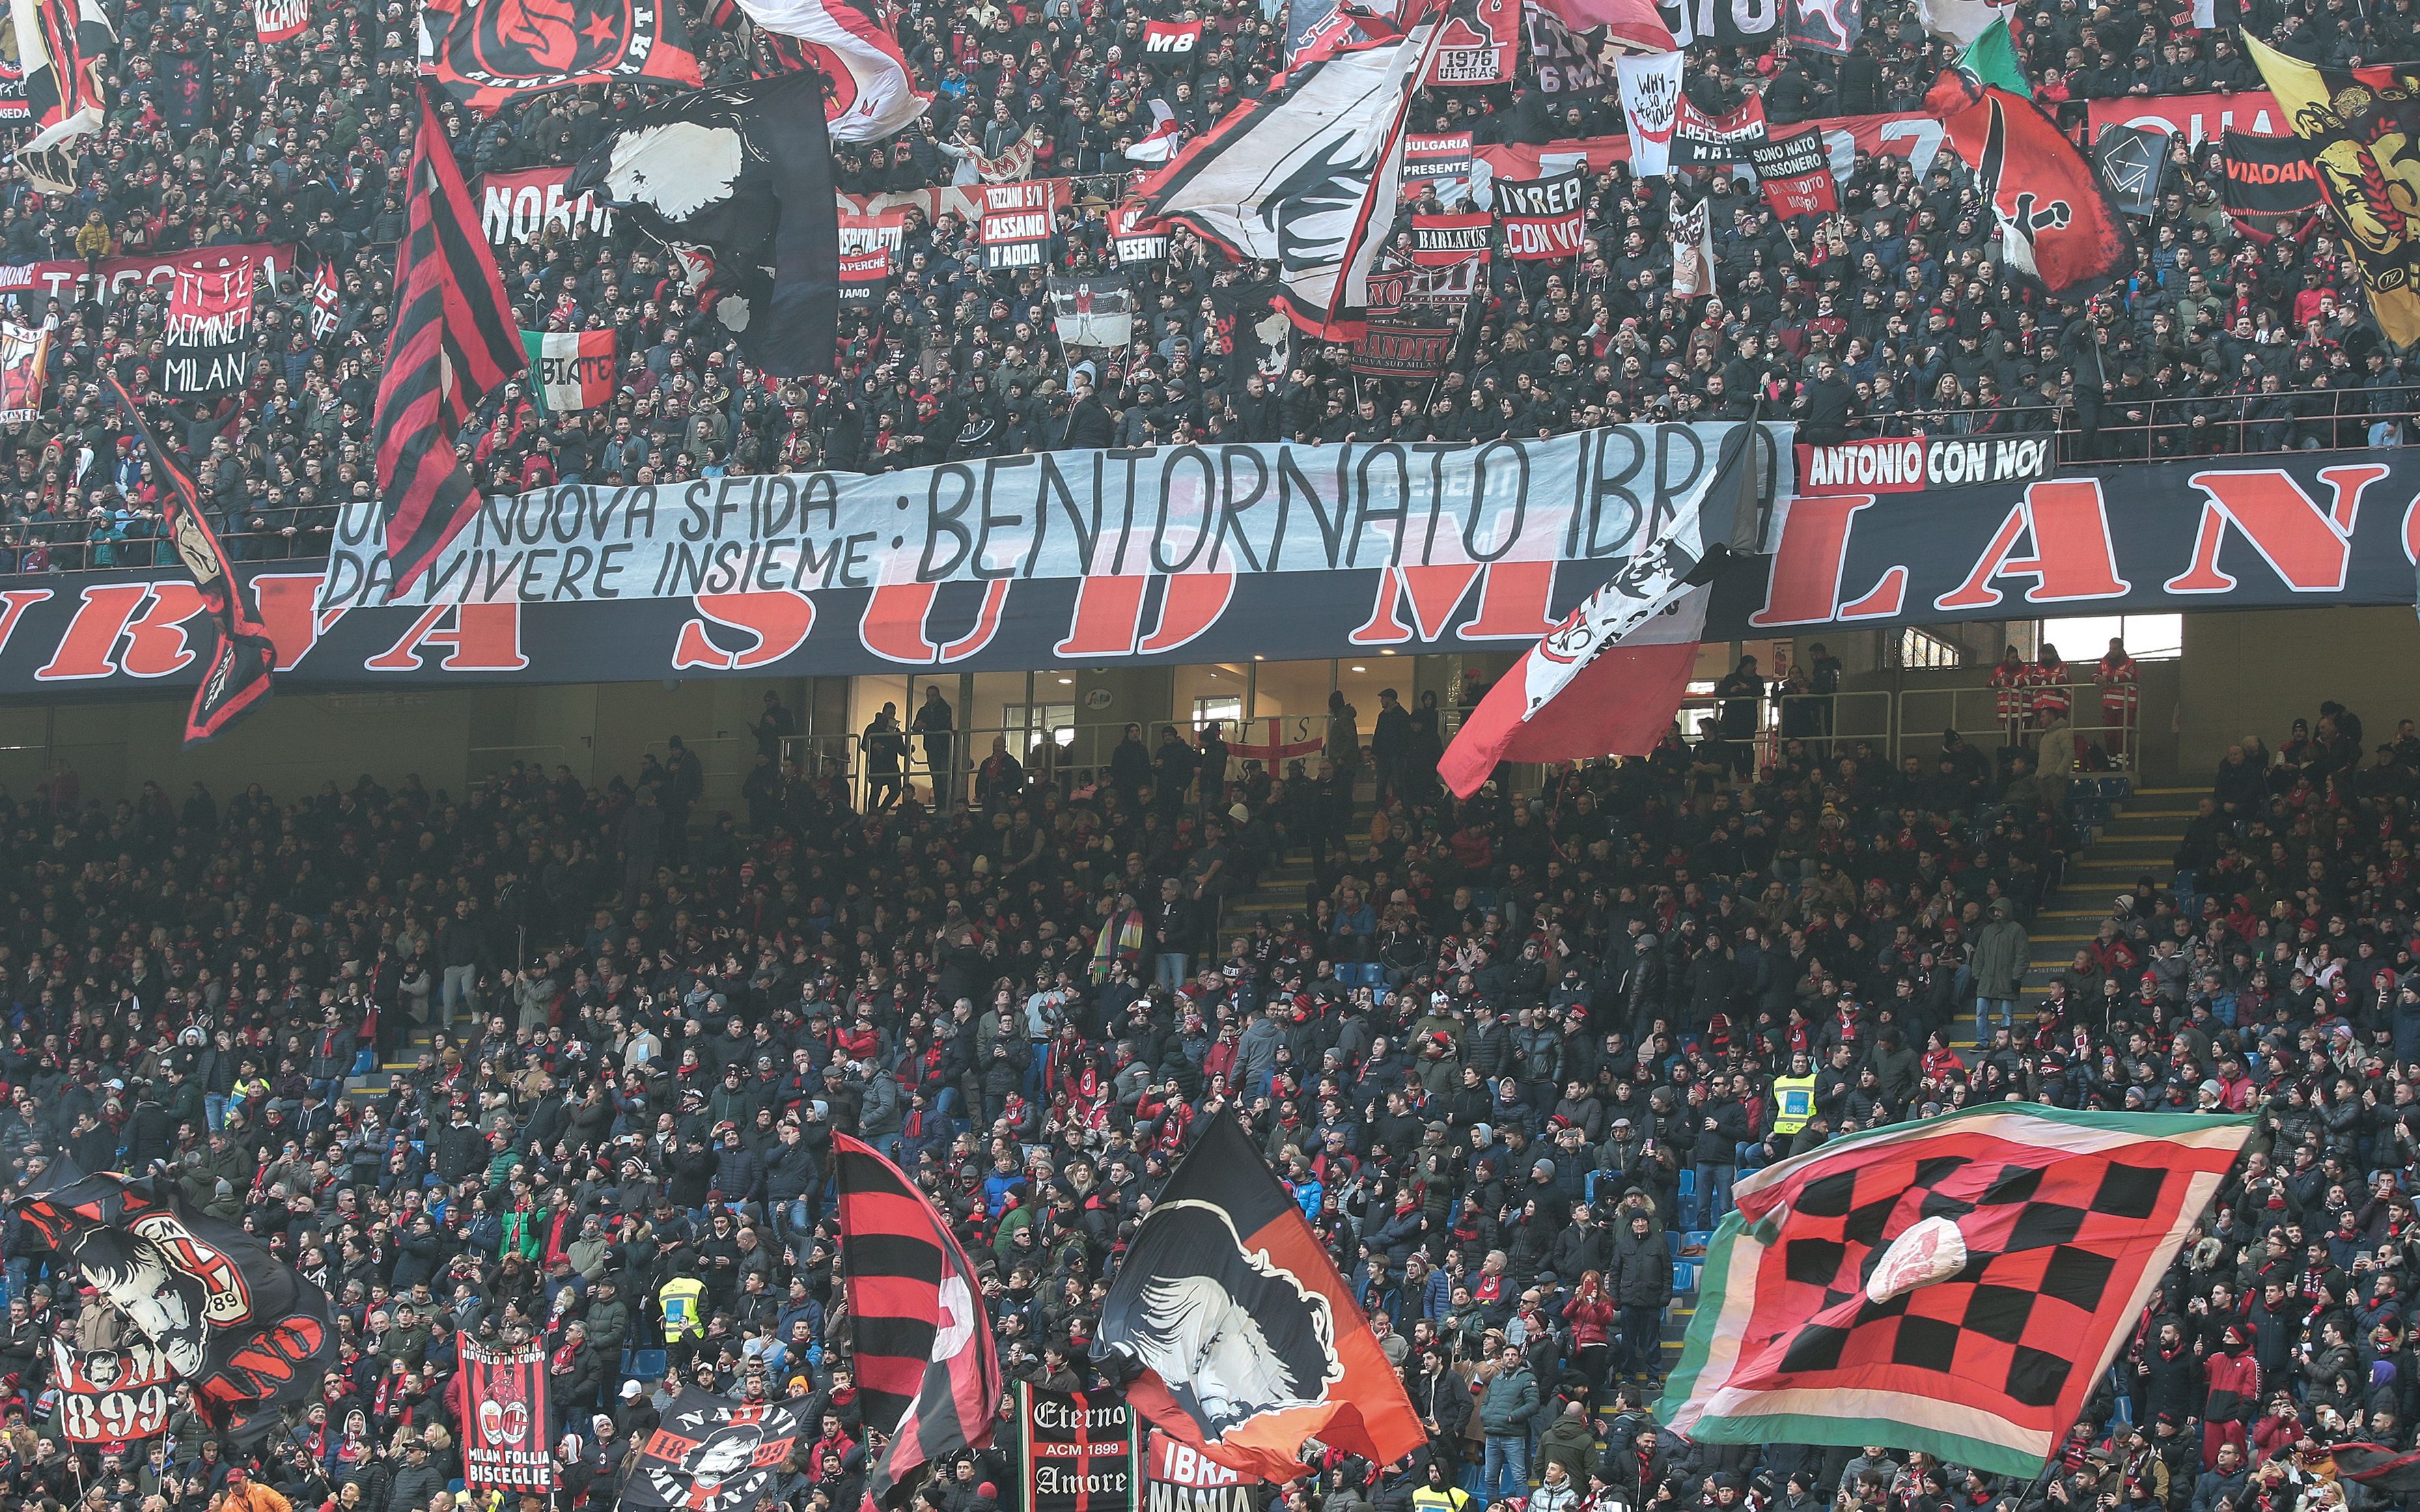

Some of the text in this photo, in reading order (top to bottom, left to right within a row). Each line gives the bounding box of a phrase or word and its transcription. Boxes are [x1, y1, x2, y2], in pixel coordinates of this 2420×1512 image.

[1147, 32, 1195, 53] MB
[1446, 51, 1492, 68] 1976
[1439, 67, 1497, 79] ULTRAS
[1637, 73, 1665, 96] WHY
[1648, 96, 1660, 108] SO
[1728, 107, 1748, 126] TI
[1676, 120, 1764, 145] LASCEREMO
[1406, 139, 1469, 152] BULGARIA
[1752, 136, 1816, 163] SONO NATO
[1404, 162, 1469, 176] PRESENTE
[1757, 154, 1822, 178] ROSSONERO
[1499, 178, 1582, 214] IVREA
[985, 214, 1046, 240] CASSANO
[1507, 220, 1554, 254] CON
[847, 254, 885, 271] PERCHÈ
[989, 243, 1040, 267] D'ADDA
[178, 263, 249, 307] TI TE
[844, 288, 870, 298] AMO
[167, 306, 249, 348] DOMINET
[1352, 334, 1450, 361] BANDITI
[164, 351, 246, 392] MILAN
[1384, 360, 1404, 368] SUD
[1809, 438, 2048, 486] ANTONIO CON NOI
[473, 484, 658, 547] NUOVA
[679, 472, 838, 542] SFIDA
[915, 439, 1530, 583] BENTORNATO
[423, 542, 634, 604] VIVERE
[652, 531, 878, 598] INSIEME
[462, 1349, 546, 1366] DIAVOLO IN CORPO
[1033, 1400, 1127, 1430] Eterno
[468, 1447, 550, 1465] MILAN FOLLIA
[653, 1434, 686, 1460] 18
[1045, 1442, 1119, 1455] ACM 1899
[470, 1464, 551, 1485] BISCEGLIE
[1163, 1441, 1238, 1486] IBRA
[645, 1465, 768, 1511] MILANO
[1035, 1466, 1127, 1495] Amore
[1150, 1481, 1254, 1512] MANIA
